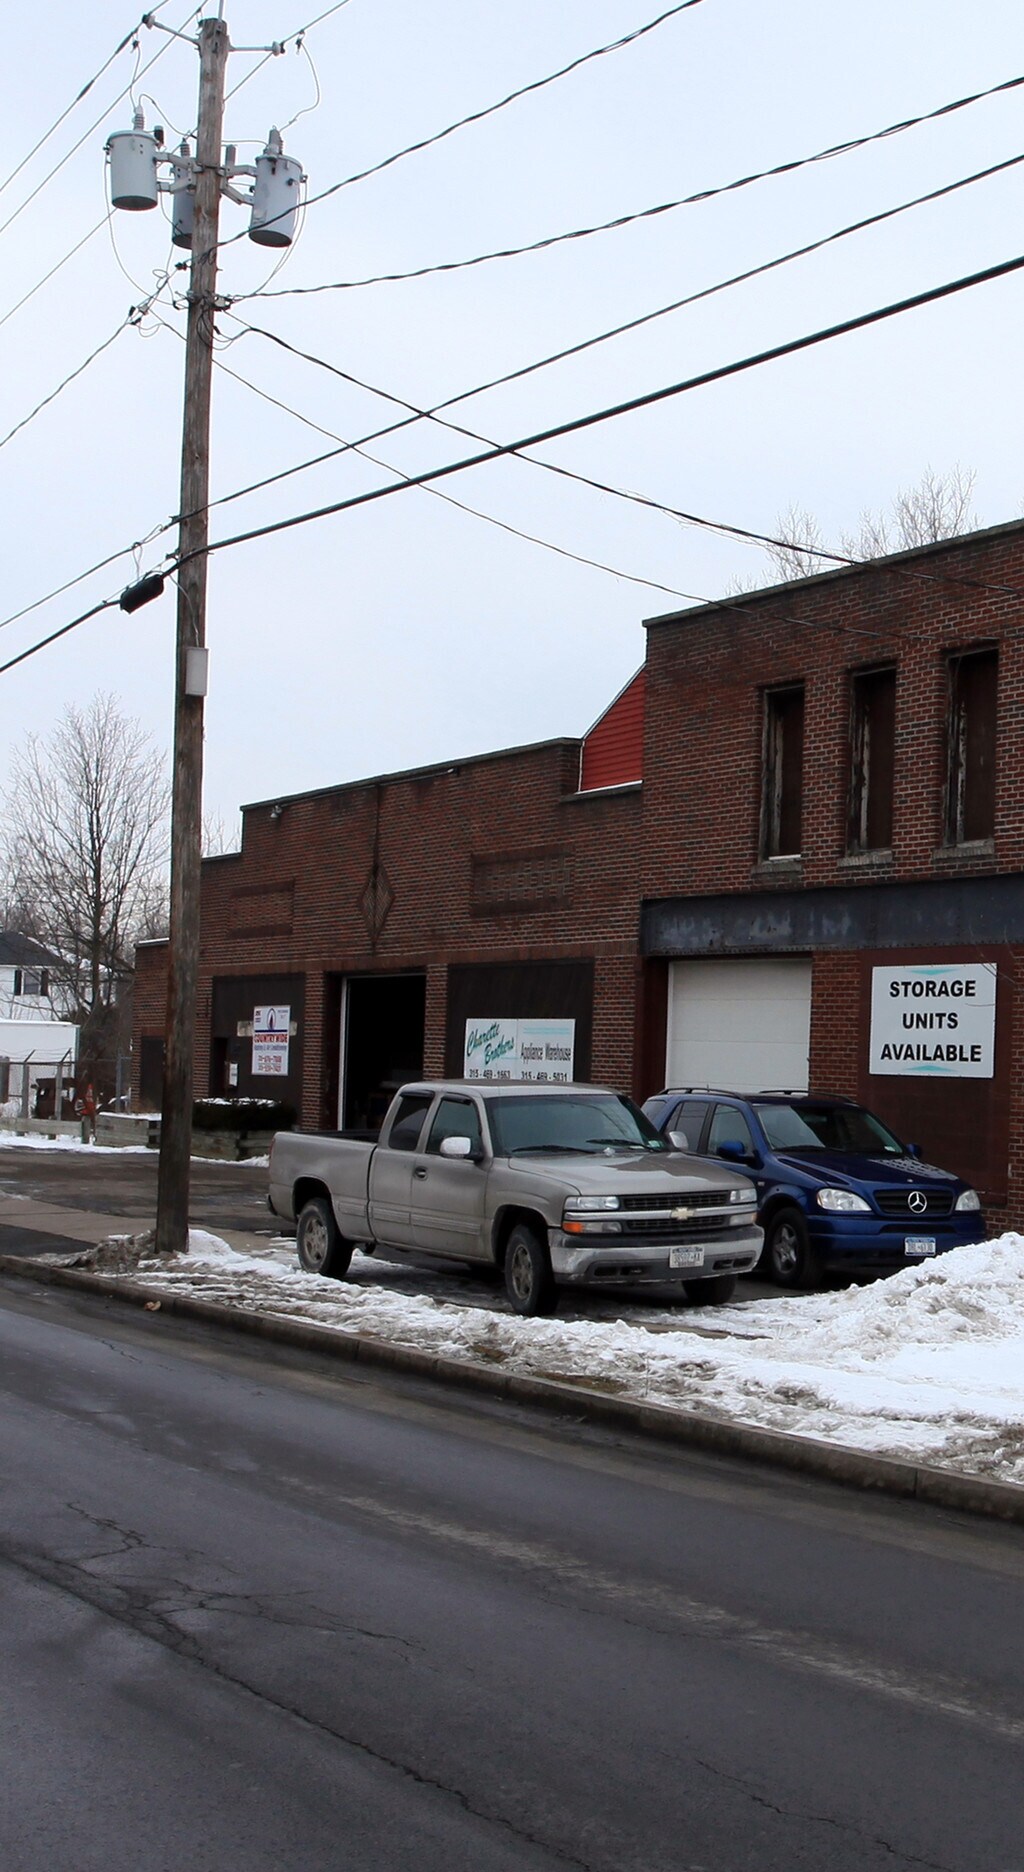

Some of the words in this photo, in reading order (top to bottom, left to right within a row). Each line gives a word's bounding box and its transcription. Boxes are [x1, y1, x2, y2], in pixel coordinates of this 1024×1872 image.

[889, 980, 976, 997] STORAGE
[902, 1012, 958, 1029] UNITS
[880, 1044, 982, 1062] AVAILABLE
